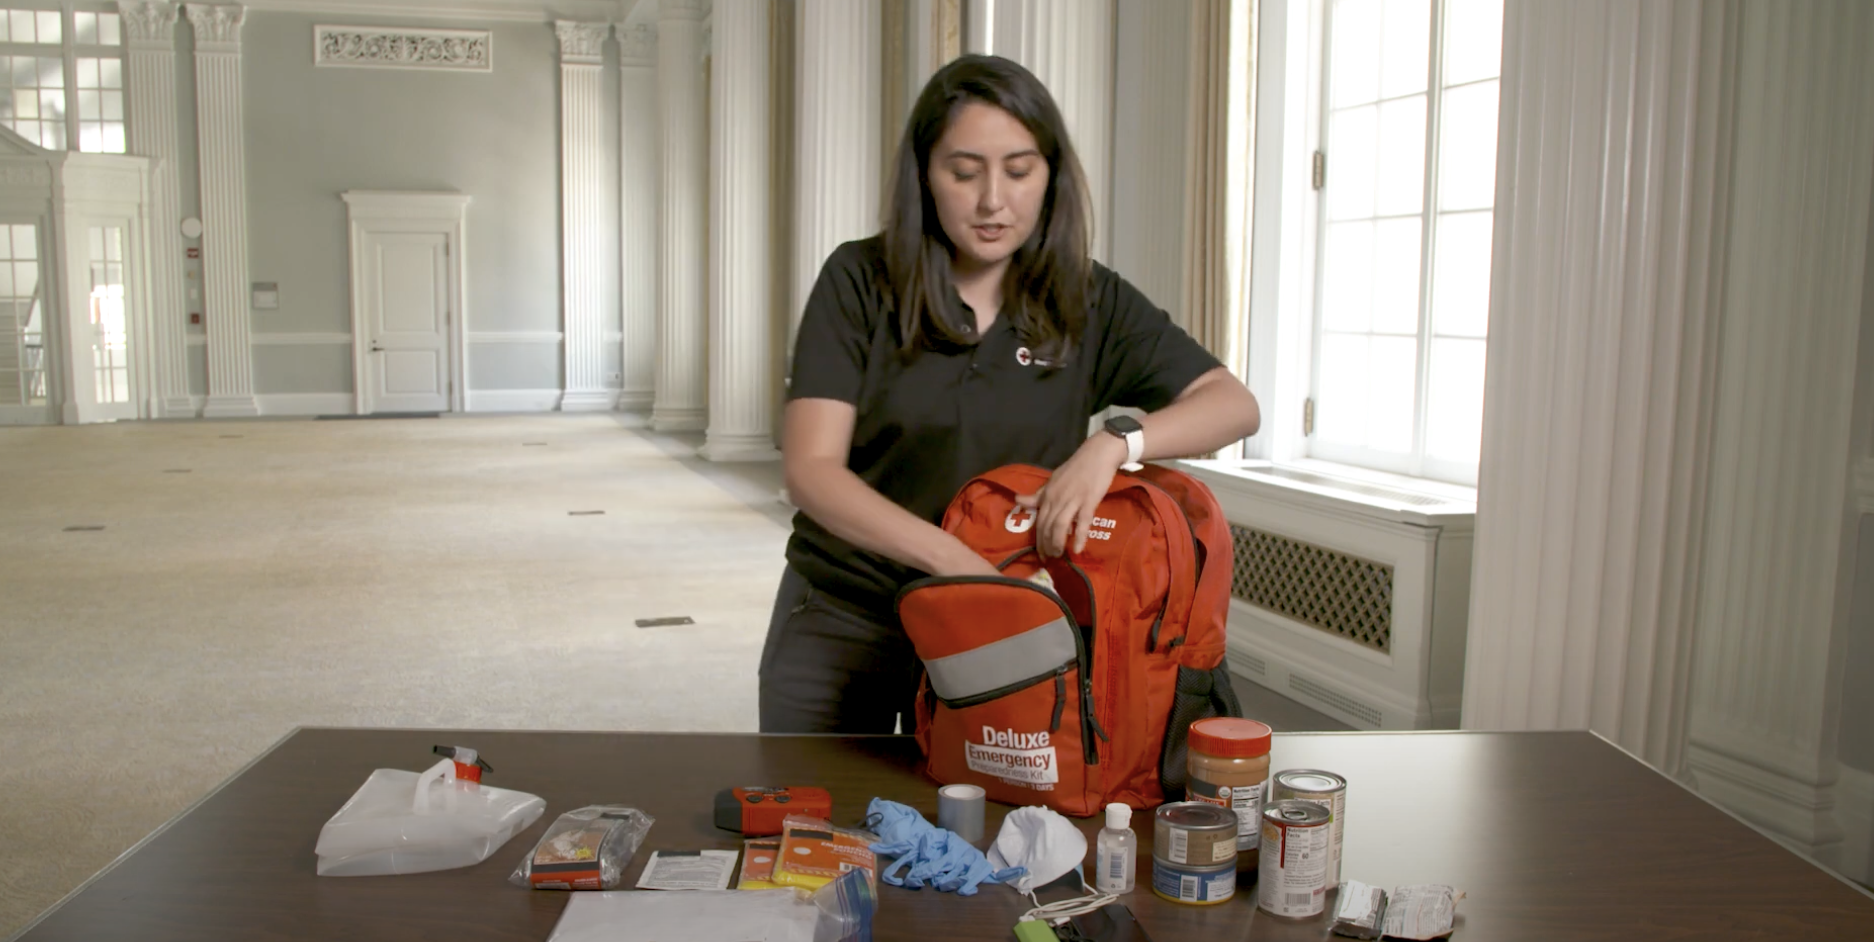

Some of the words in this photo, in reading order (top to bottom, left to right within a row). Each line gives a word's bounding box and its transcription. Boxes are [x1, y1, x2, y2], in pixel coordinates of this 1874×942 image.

[1092, 517, 1116, 528] can
[983, 725, 1050, 749] Deluxe
[968, 744, 1051, 771] Emergency
[971, 760, 1029, 779] Preparedness
[1030, 769, 1044, 780] Kit
[1036, 783, 1055, 792] DAYS
[1301, 852, 1309, 860] 60
